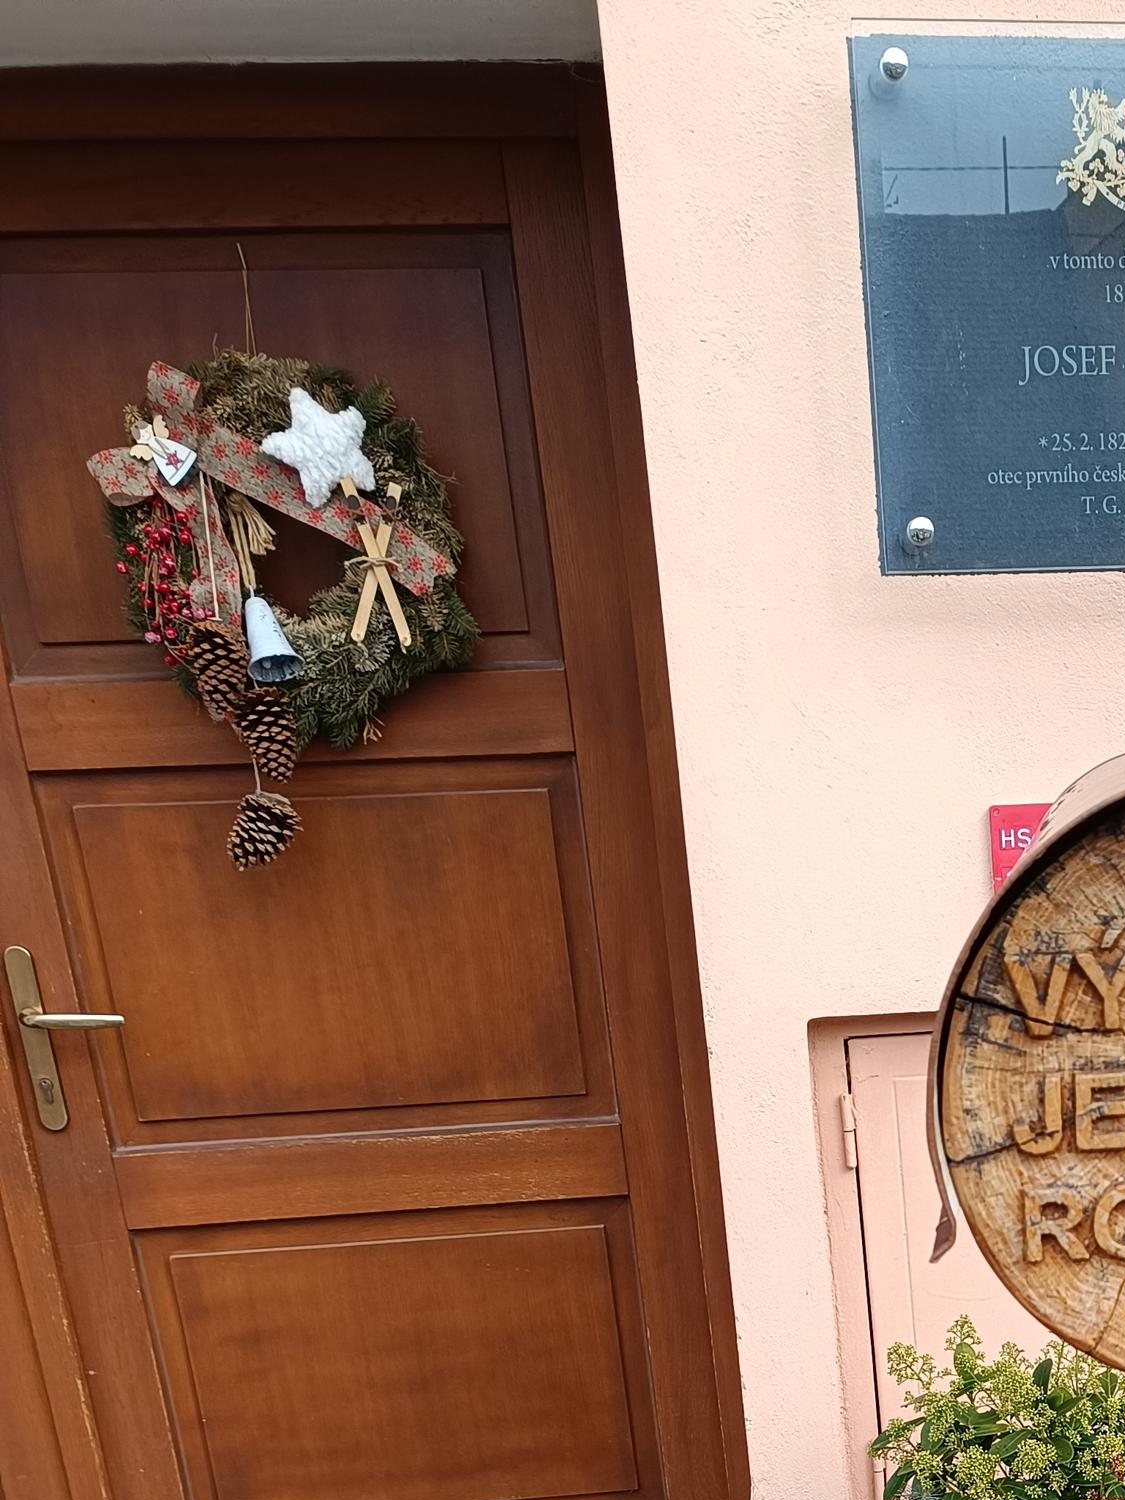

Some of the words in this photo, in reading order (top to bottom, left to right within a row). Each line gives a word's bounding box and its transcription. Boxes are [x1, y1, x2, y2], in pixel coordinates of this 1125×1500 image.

[1050, 255, 1060, 268] v
[1063, 252, 1114, 268] tomto
[1018, 344, 1116, 386] JOSEF
[987, 469, 1022, 484] otec
[1026, 463, 1090, 490] prvního
